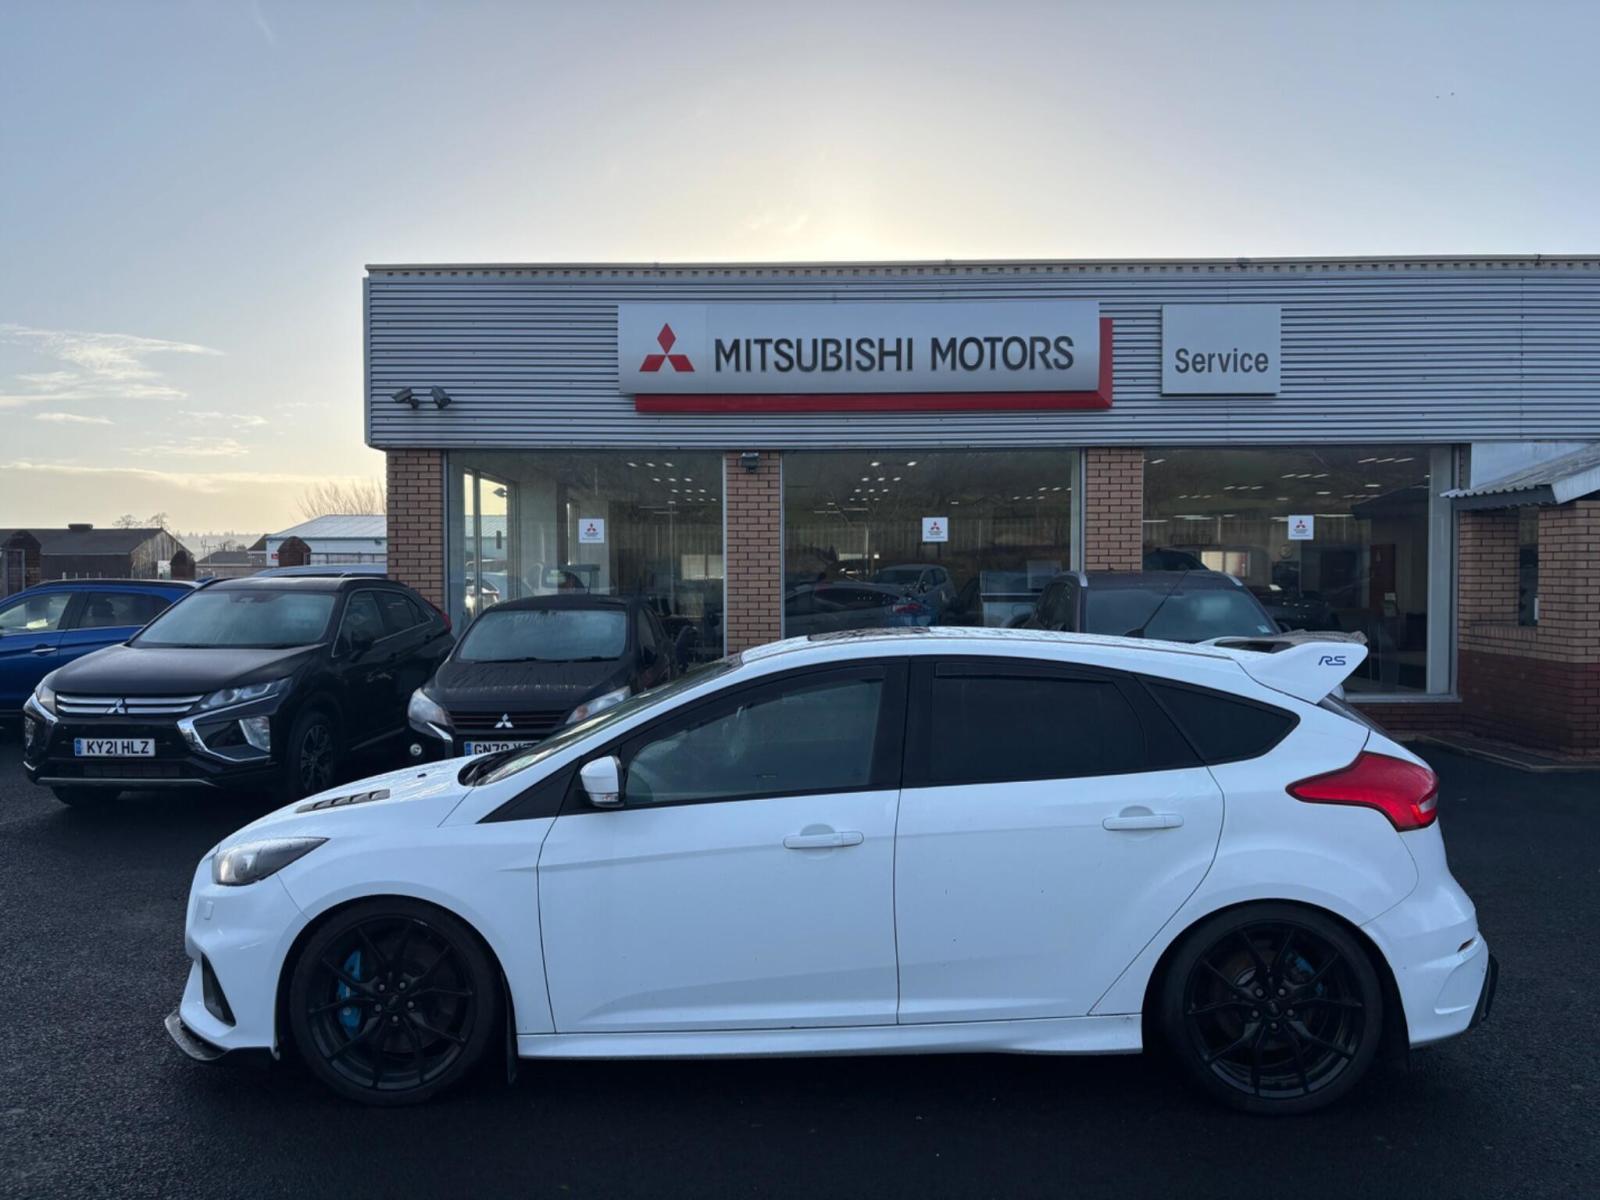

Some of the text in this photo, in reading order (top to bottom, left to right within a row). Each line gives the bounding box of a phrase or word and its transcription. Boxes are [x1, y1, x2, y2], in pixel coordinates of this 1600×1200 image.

[715, 336, 1075, 373] MITSUBISHI MOTORS
[1175, 347, 1269, 374] Service
[1317, 655, 1347, 666] RS
[86, 740, 150, 754] KY21 HLZ
